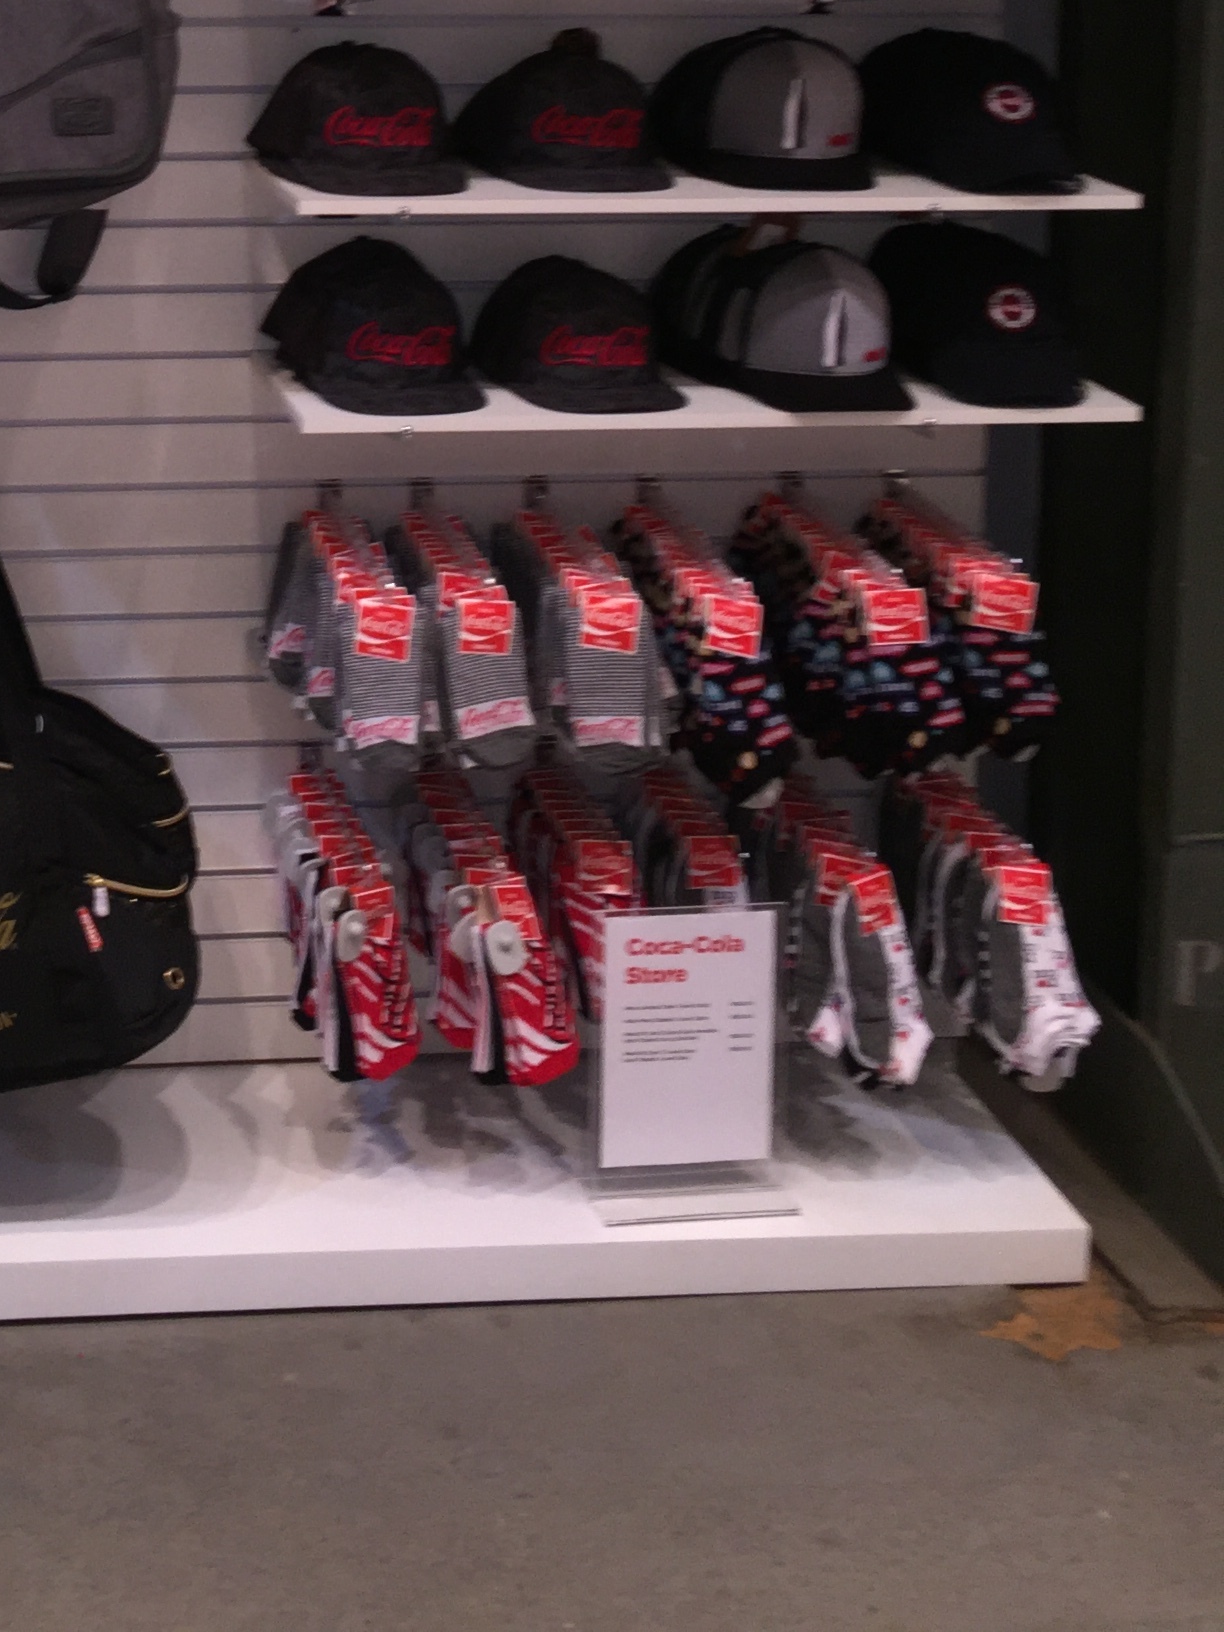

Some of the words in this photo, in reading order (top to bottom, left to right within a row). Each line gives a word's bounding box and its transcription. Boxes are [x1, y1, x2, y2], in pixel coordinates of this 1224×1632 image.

[323, 105, 437, 148] Coca-Cola
[531, 105, 645, 149] Coca-Cola
[346, 323, 457, 366] Coca-Cola
[539, 325, 653, 366] Coca-Cola
[626, 935, 745, 956] Coca-Cola
[625, 966, 688, 984] Store
